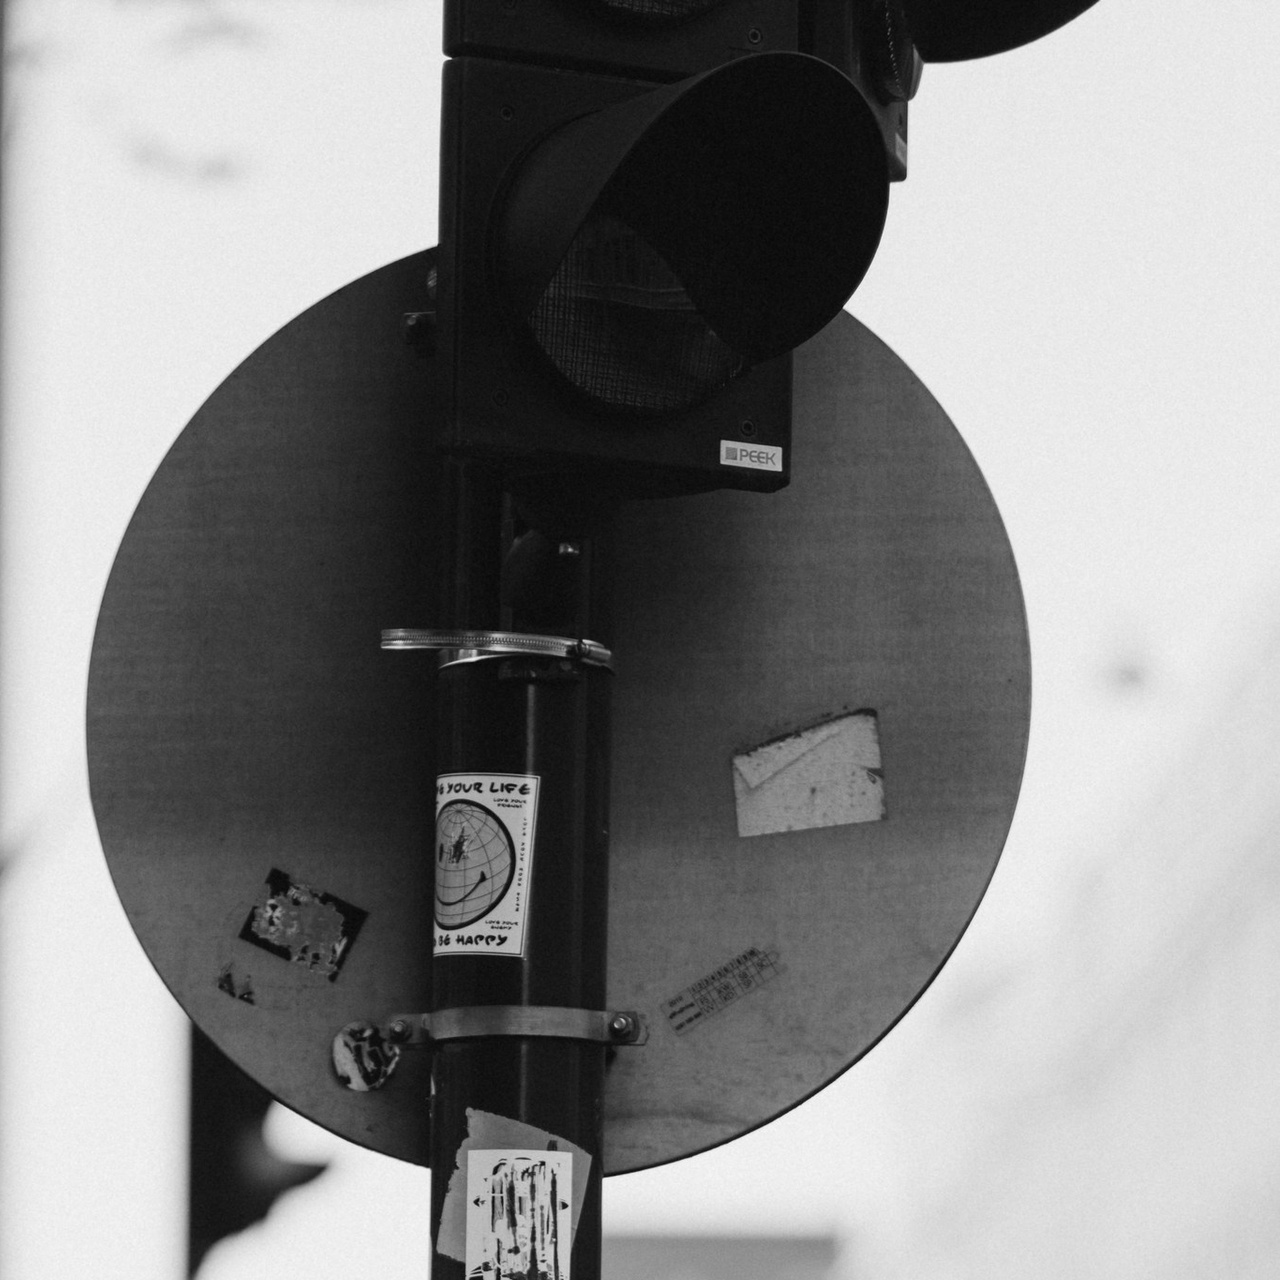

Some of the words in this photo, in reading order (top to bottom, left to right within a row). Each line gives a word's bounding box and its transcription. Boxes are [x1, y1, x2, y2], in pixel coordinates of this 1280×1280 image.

[739, 448, 776, 466] PEEK
[447, 782, 483, 794] YOUR
[489, 781, 531, 796] LIFE
[438, 933, 451, 947] BE
[455, 934, 508, 947] HAPPY
